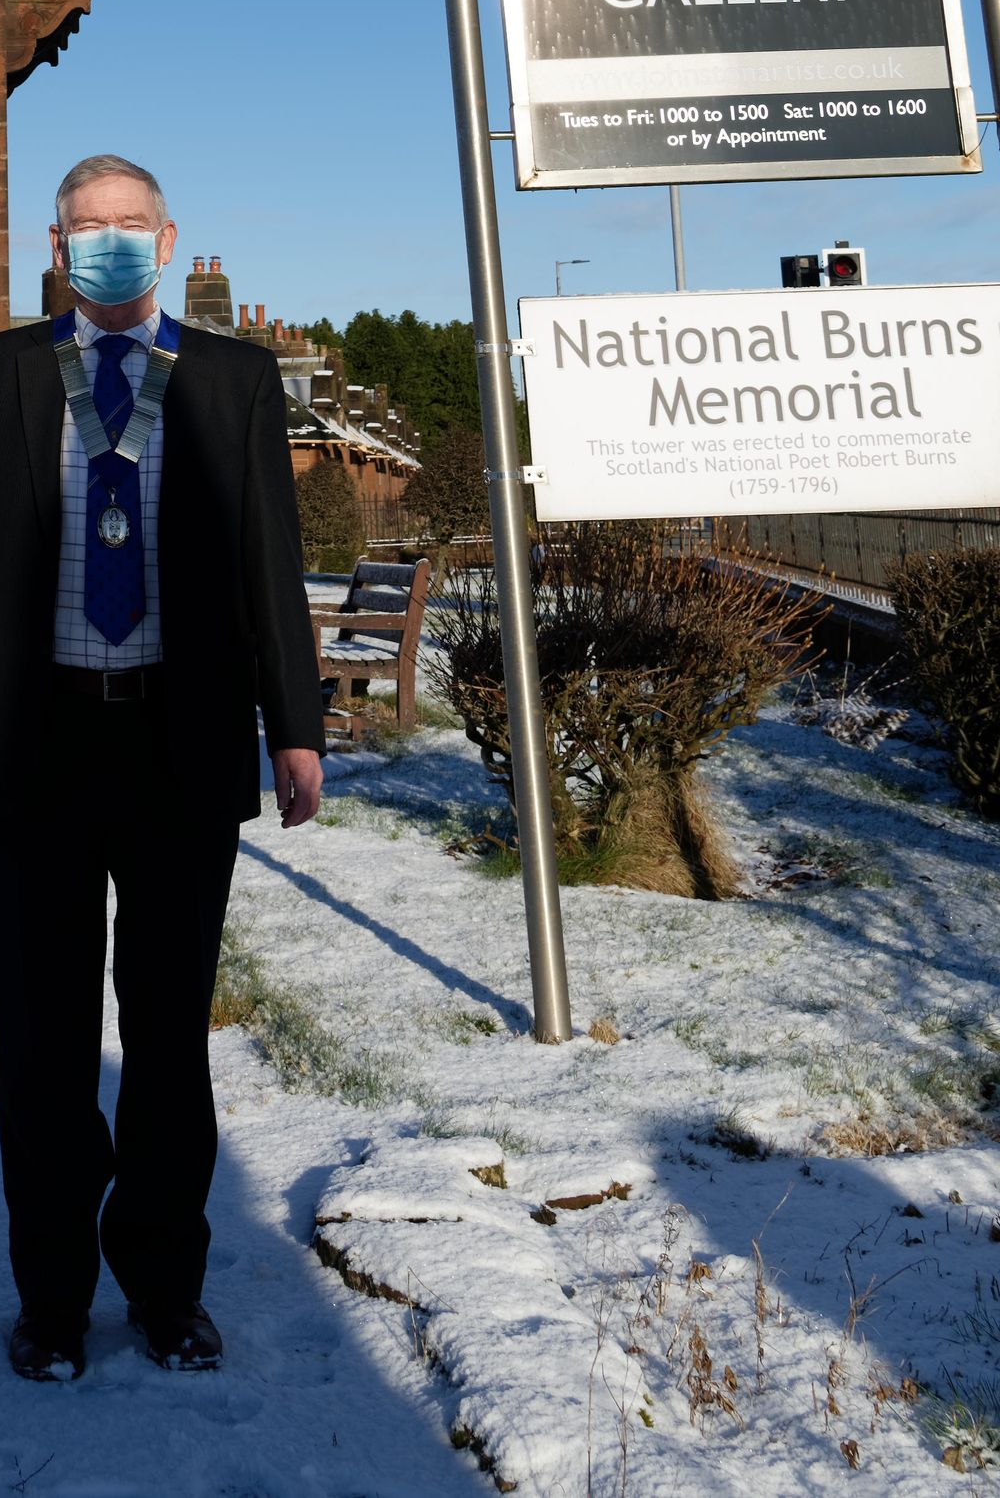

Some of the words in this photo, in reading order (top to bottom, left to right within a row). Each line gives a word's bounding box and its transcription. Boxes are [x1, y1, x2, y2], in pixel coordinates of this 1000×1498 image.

[560, 112, 599, 127] Tues
[603, 114, 622, 126] to
[627, 110, 654, 125] Fri:
[660, 107, 699, 123] 1000
[703, 110, 722, 121] to
[730, 105, 768, 120] 1500
[784, 103, 813, 118] Sat:
[819, 101, 857, 117] 1000
[862, 105, 880, 116] to
[889, 99, 926, 115] 1600
[667, 135, 687, 146] or
[692, 130, 711, 149] by
[717, 128, 826, 147] Appointment
[553, 311, 799, 368] National
[821, 311, 981, 358] Burns
[650, 368, 921, 426] Memorial
[586, 440, 624, 455] This
[632, 441, 684, 454] tower
[692, 440, 726, 451] was
[733, 433, 804, 450] erected
[812, 434, 830, 448] to
[838, 430, 971, 447] commemorate
[607, 458, 697, 476] Scotland's
[705, 454, 781, 472] National
[790, 454, 830, 469] Poet
[837, 451, 898, 467] Robert
[906, 450, 956, 465] Burns
[730, 477, 837, 497] (1759-1796)
